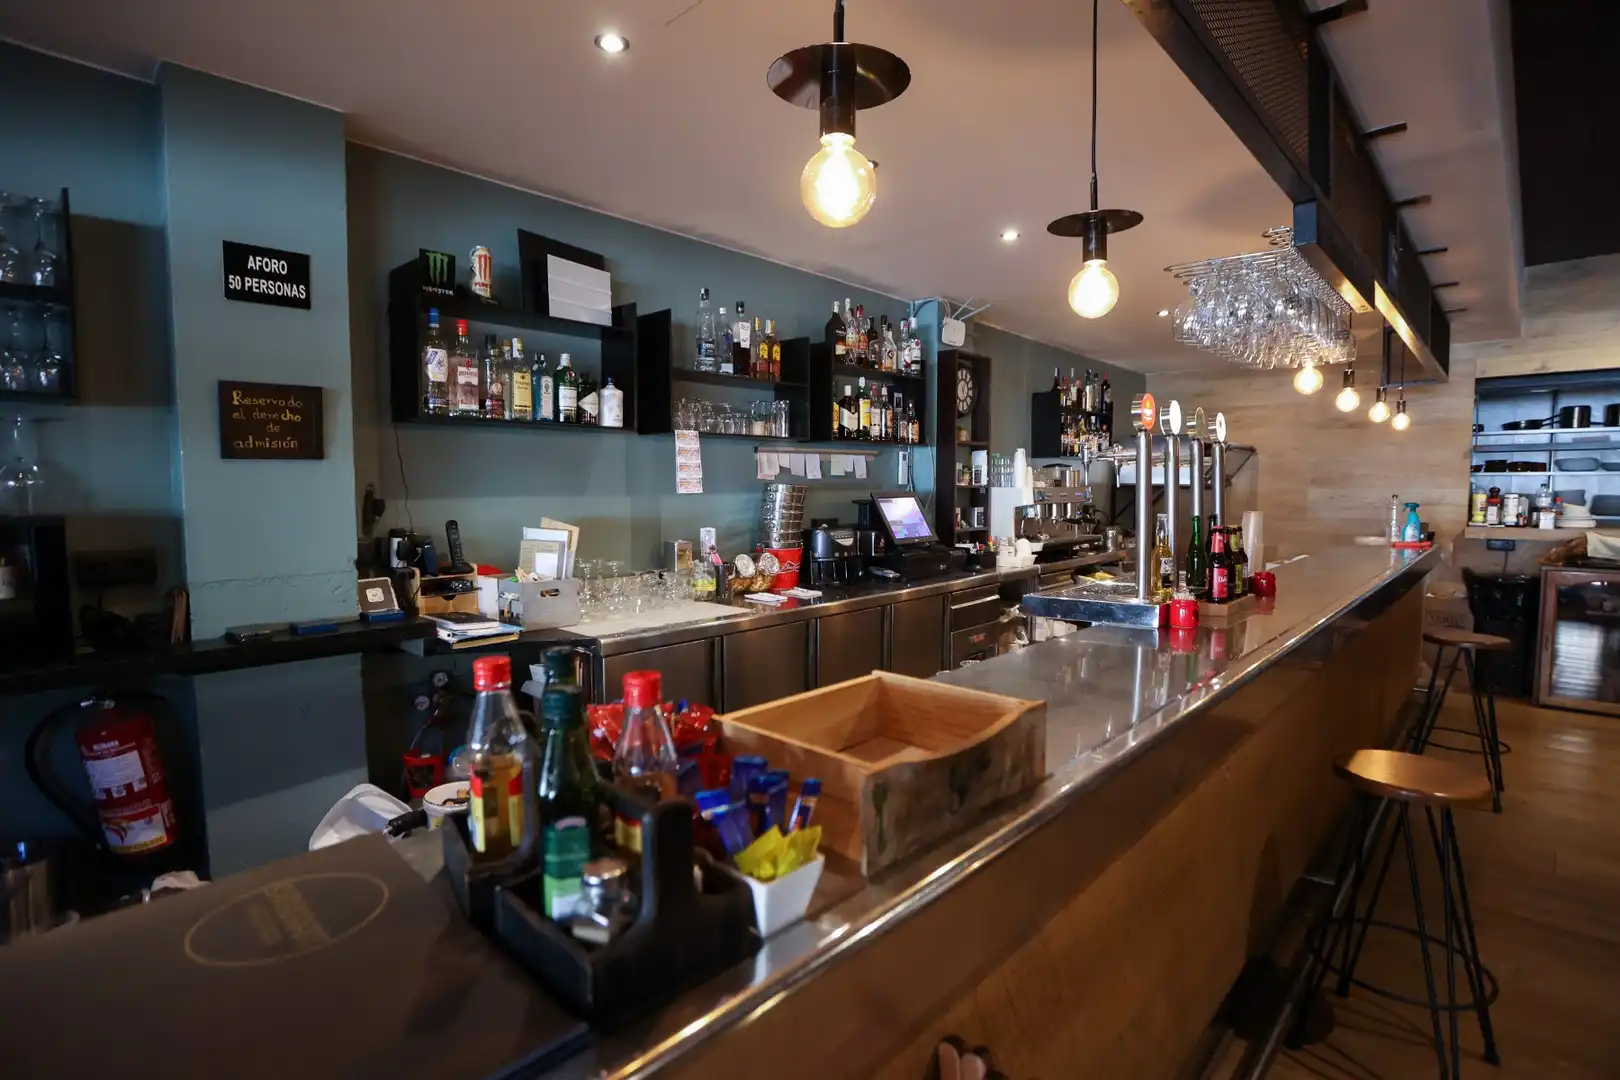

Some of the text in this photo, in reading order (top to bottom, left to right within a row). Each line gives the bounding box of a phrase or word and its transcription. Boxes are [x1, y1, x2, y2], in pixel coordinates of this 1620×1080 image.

[247, 255, 287, 275] AFORO
[228, 275, 306, 299] 50 PERSONAS
[232, 389, 303, 408] Reservado
[232, 407, 301, 422] el derecho
[266, 422, 281, 433] de
[233, 435, 298, 449] admisión
